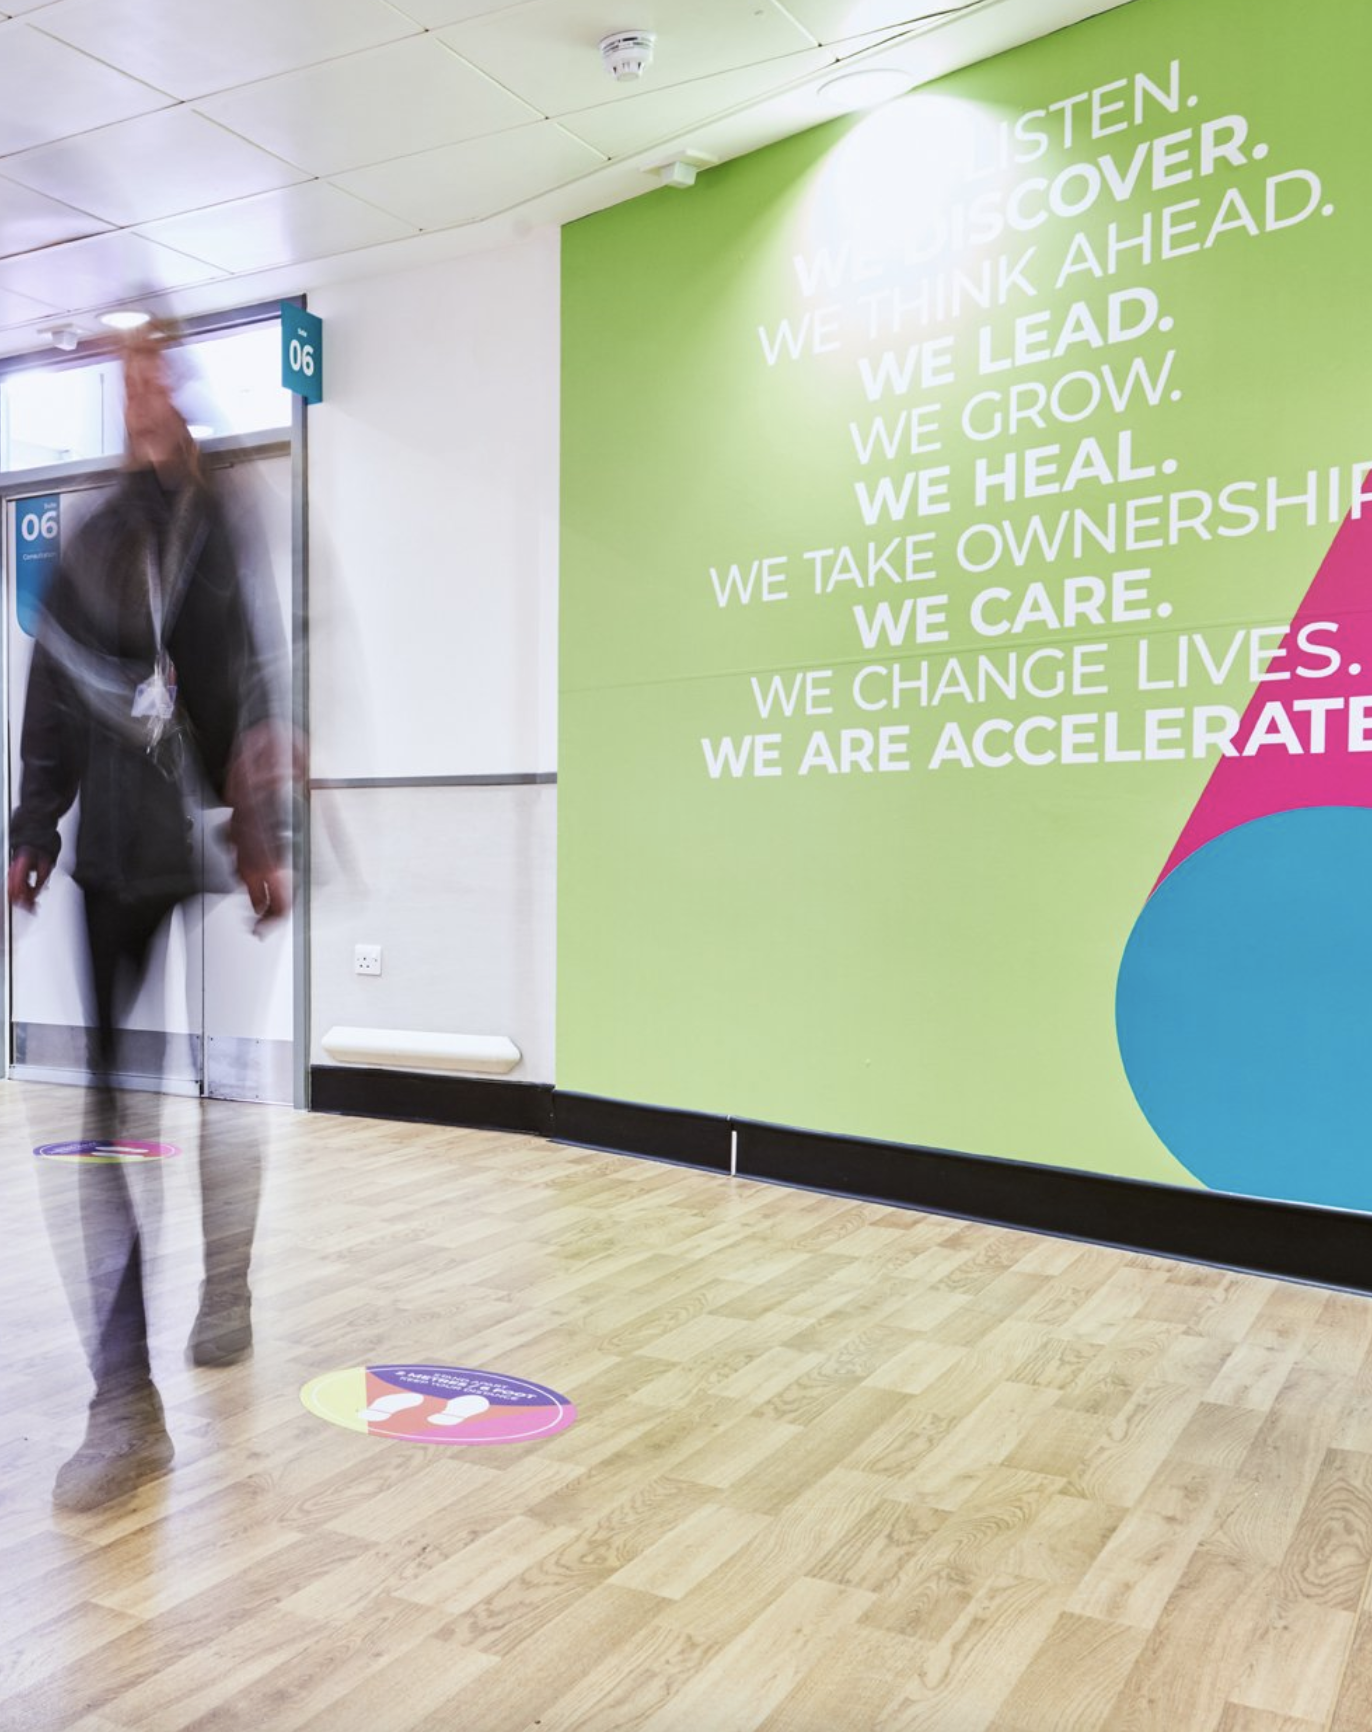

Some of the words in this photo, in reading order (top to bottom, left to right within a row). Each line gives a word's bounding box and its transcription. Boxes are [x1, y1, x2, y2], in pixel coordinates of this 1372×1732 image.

[793, 230, 882, 297] WE
[911, 115, 1268, 264] DISCOVER.
[758, 309, 841, 367] WE
[864, 247, 1038, 341] THINK
[1054, 169, 1334, 290] AHEAD.
[289, 339, 315, 377] 06
[858, 336, 955, 401] WE
[978, 287, 1174, 375] LEAD.
[849, 409, 942, 465] WE
[961, 349, 1183, 442] GROW.
[21, 510, 59, 542] 06
[853, 465, 951, 526] WE
[974, 429, 1178, 507] HEAL.
[709, 555, 789, 608] WE
[803, 531, 937, 595] TAKE
[852, 594, 949, 649] WE
[970, 568, 1173, 637] CARE.
[750, 669, 834, 719] WE
[852, 643, 1108, 712] CHANGE
[1138, 621, 1362, 691] LIVES.
[701, 733, 783, 779] WE
[797, 724, 911, 776] ARE
[928, 694, 1372, 770] ACCELERATE
